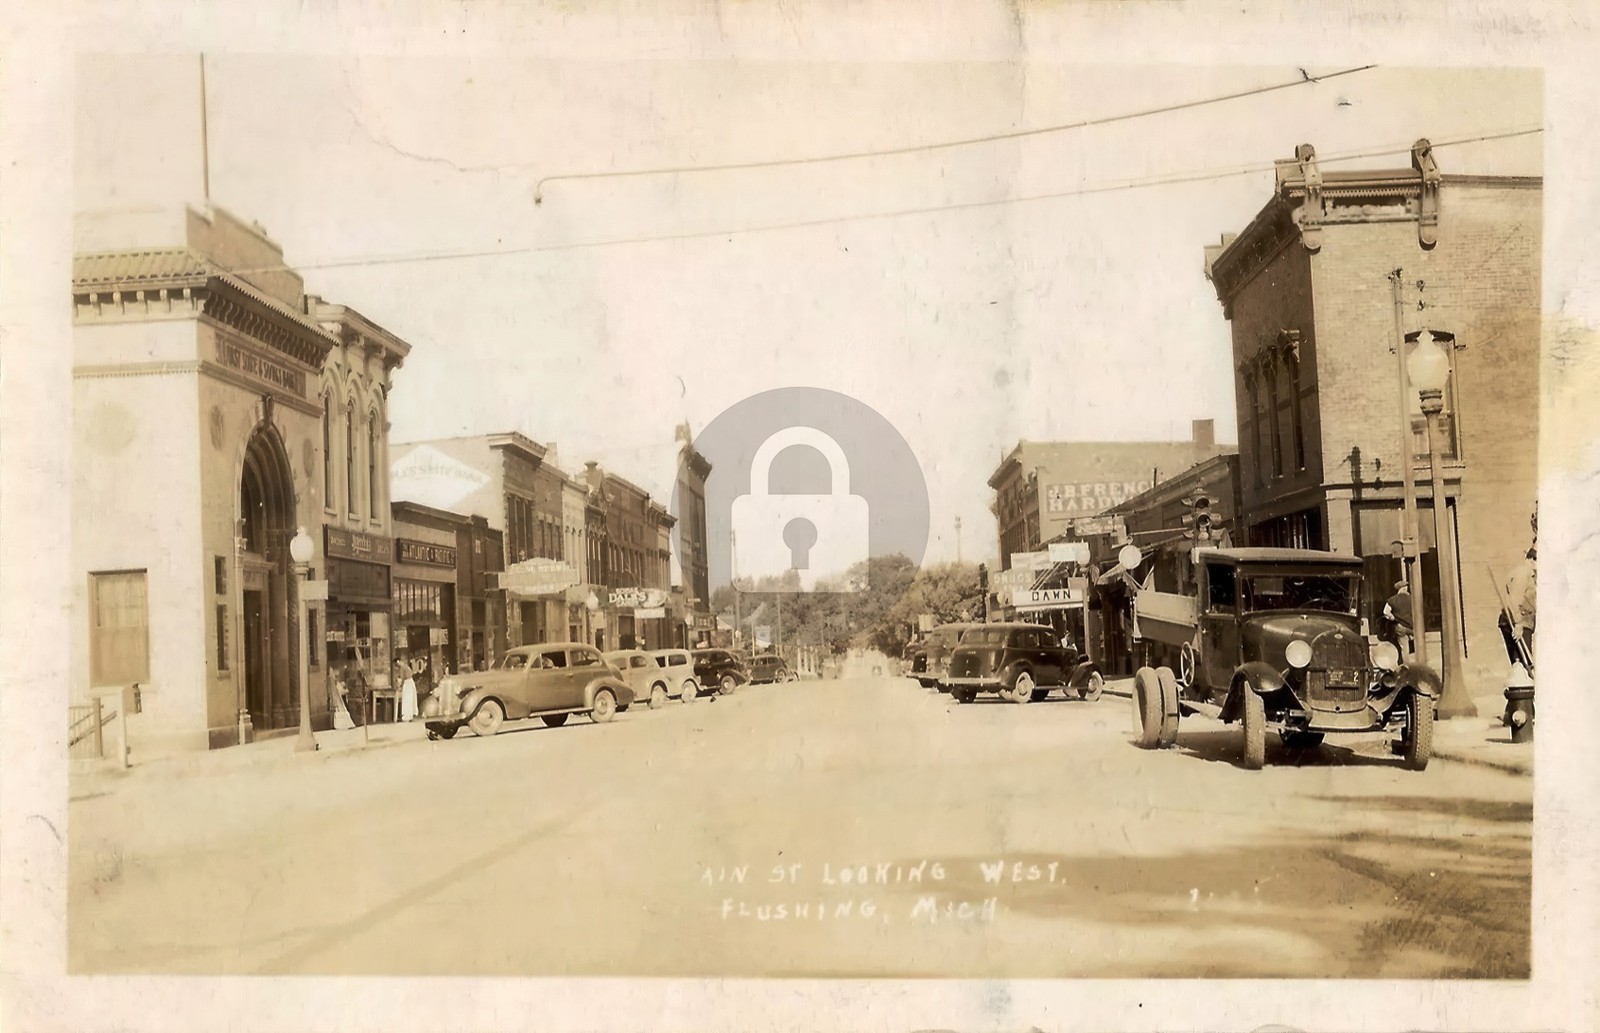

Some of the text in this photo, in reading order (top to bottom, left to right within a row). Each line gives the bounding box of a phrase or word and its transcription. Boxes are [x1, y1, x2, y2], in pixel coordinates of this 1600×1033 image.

[1080, 479, 1150, 497] FRENC
[993, 570, 1032, 584] DRUGS
[1032, 590, 1072, 602] DAWN
